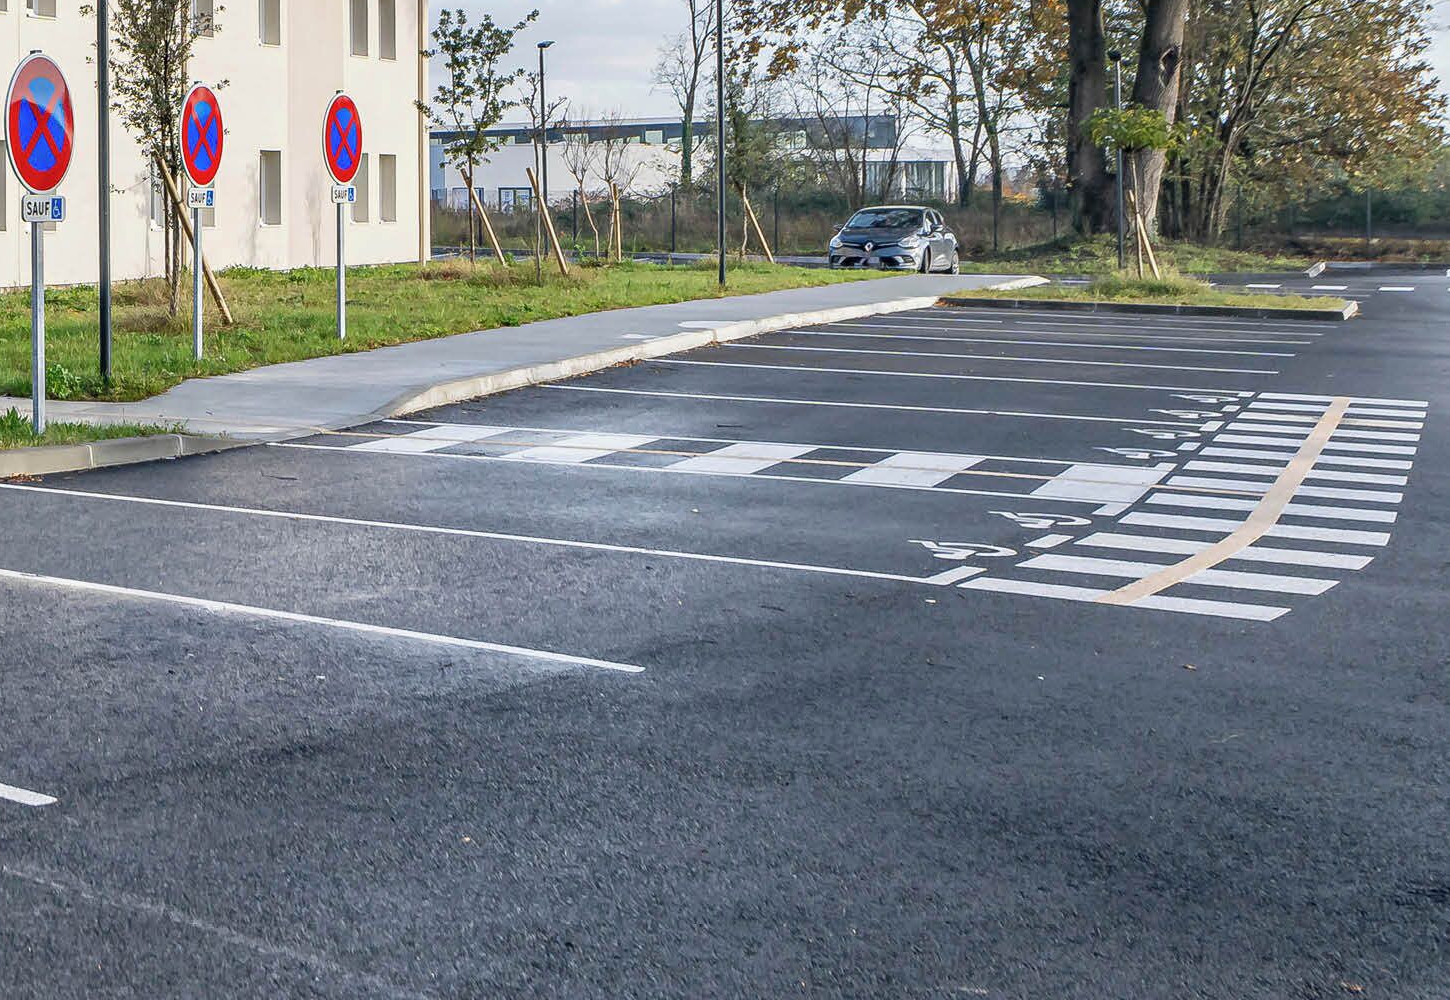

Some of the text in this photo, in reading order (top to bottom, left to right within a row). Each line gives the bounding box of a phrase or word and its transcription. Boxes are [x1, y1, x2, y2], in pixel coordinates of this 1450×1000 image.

[190, 192, 206, 204] SAUF
[334, 189, 347, 200] SAUF
[26, 201, 50, 216] SAUF
